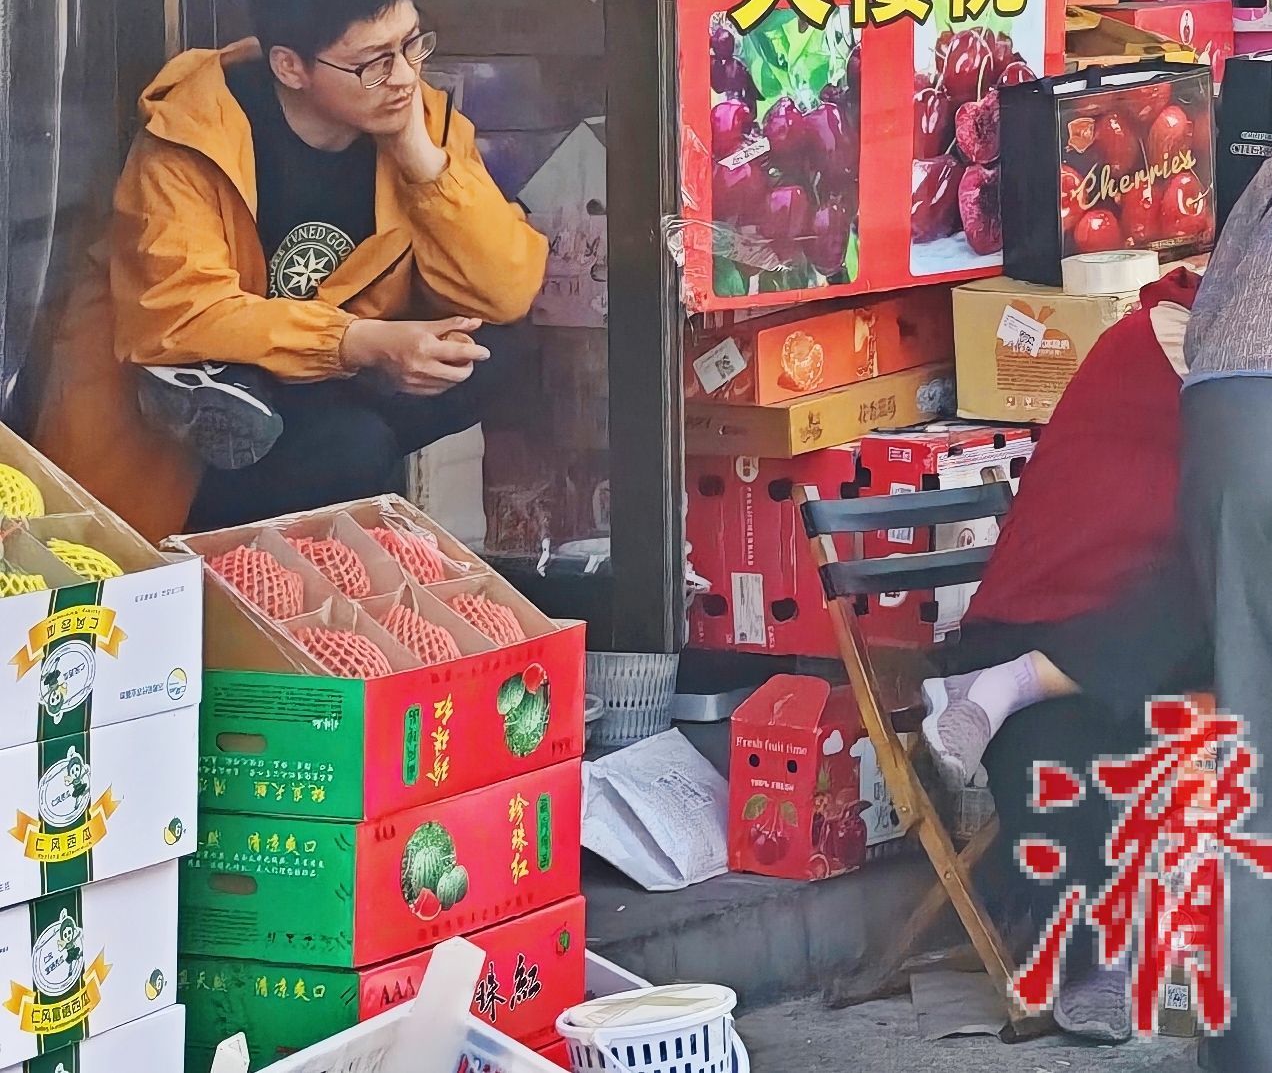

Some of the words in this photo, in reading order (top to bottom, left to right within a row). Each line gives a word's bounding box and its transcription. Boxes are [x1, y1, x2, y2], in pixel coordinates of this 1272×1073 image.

[1075, 150, 1197, 210] Cherries
[736, 735, 762, 750] Fresh
[785, 742, 807, 756] time
